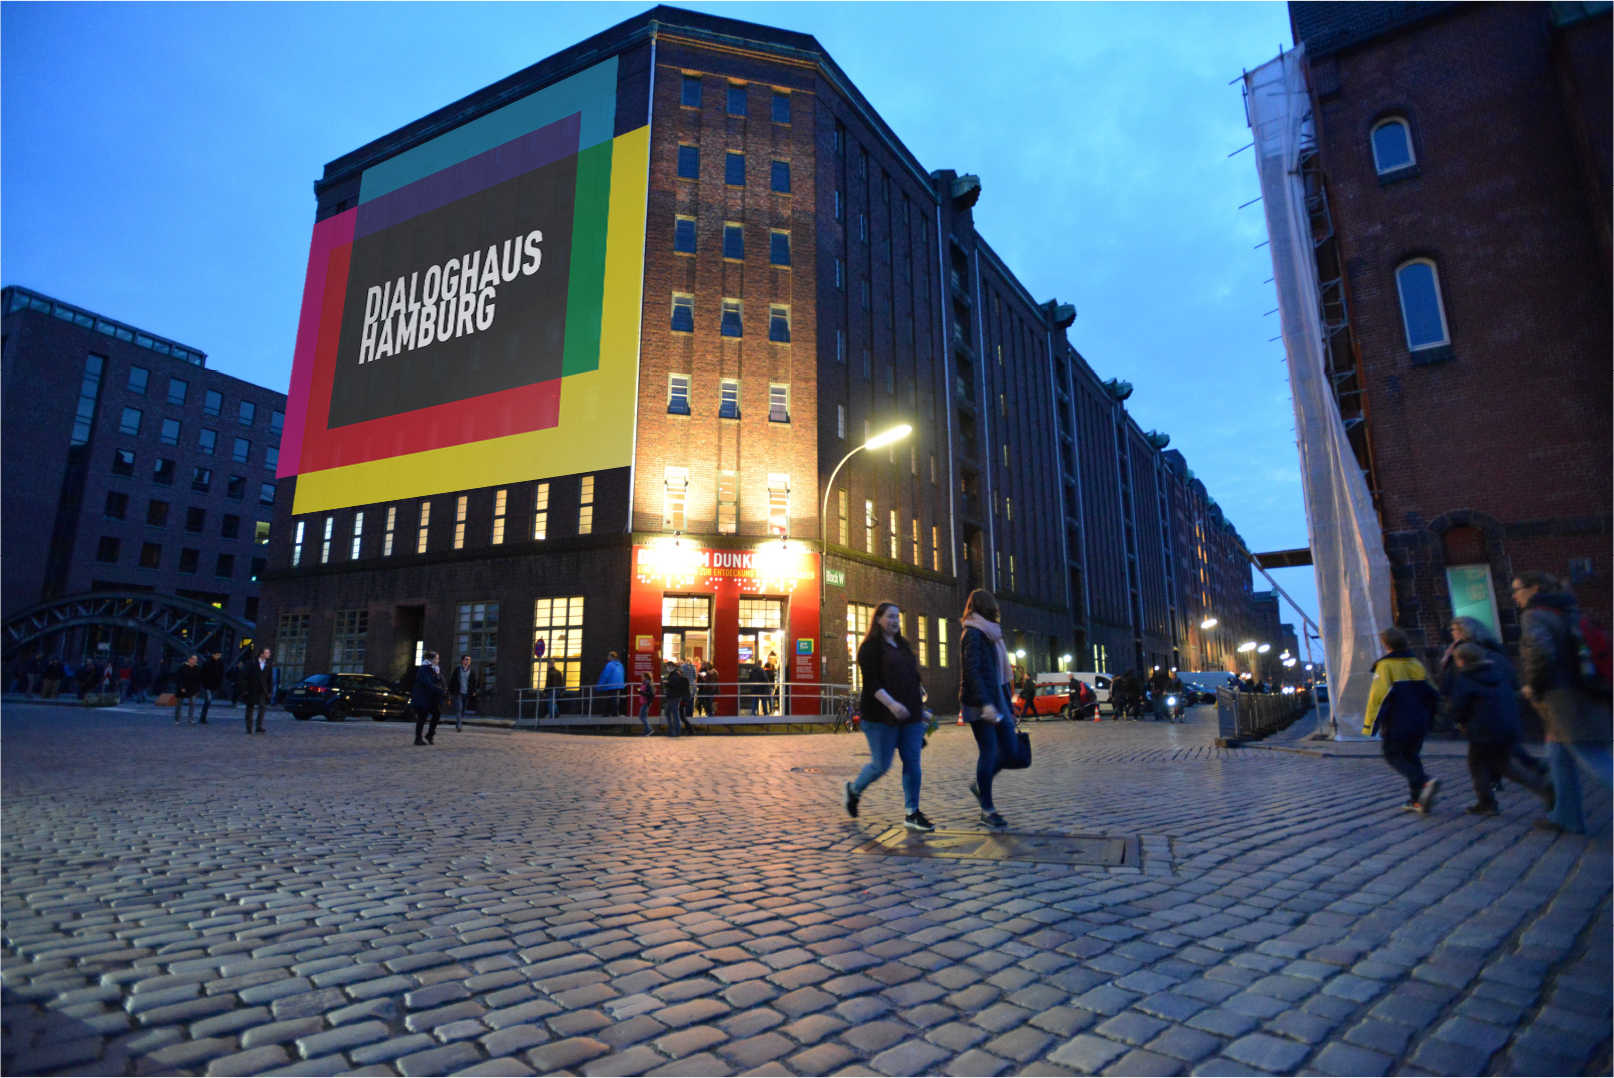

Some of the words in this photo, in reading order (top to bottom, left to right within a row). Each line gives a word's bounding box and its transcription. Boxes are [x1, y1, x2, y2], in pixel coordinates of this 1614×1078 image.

[364, 229, 543, 326] DIALOGHAUS
[358, 286, 496, 365] HAMBURG
[699, 567, 712, 576] ZUR
[713, 568, 755, 578] ENTDECKUNG
[826, 570, 839, 583] Block
[839, 572, 845, 584] W
